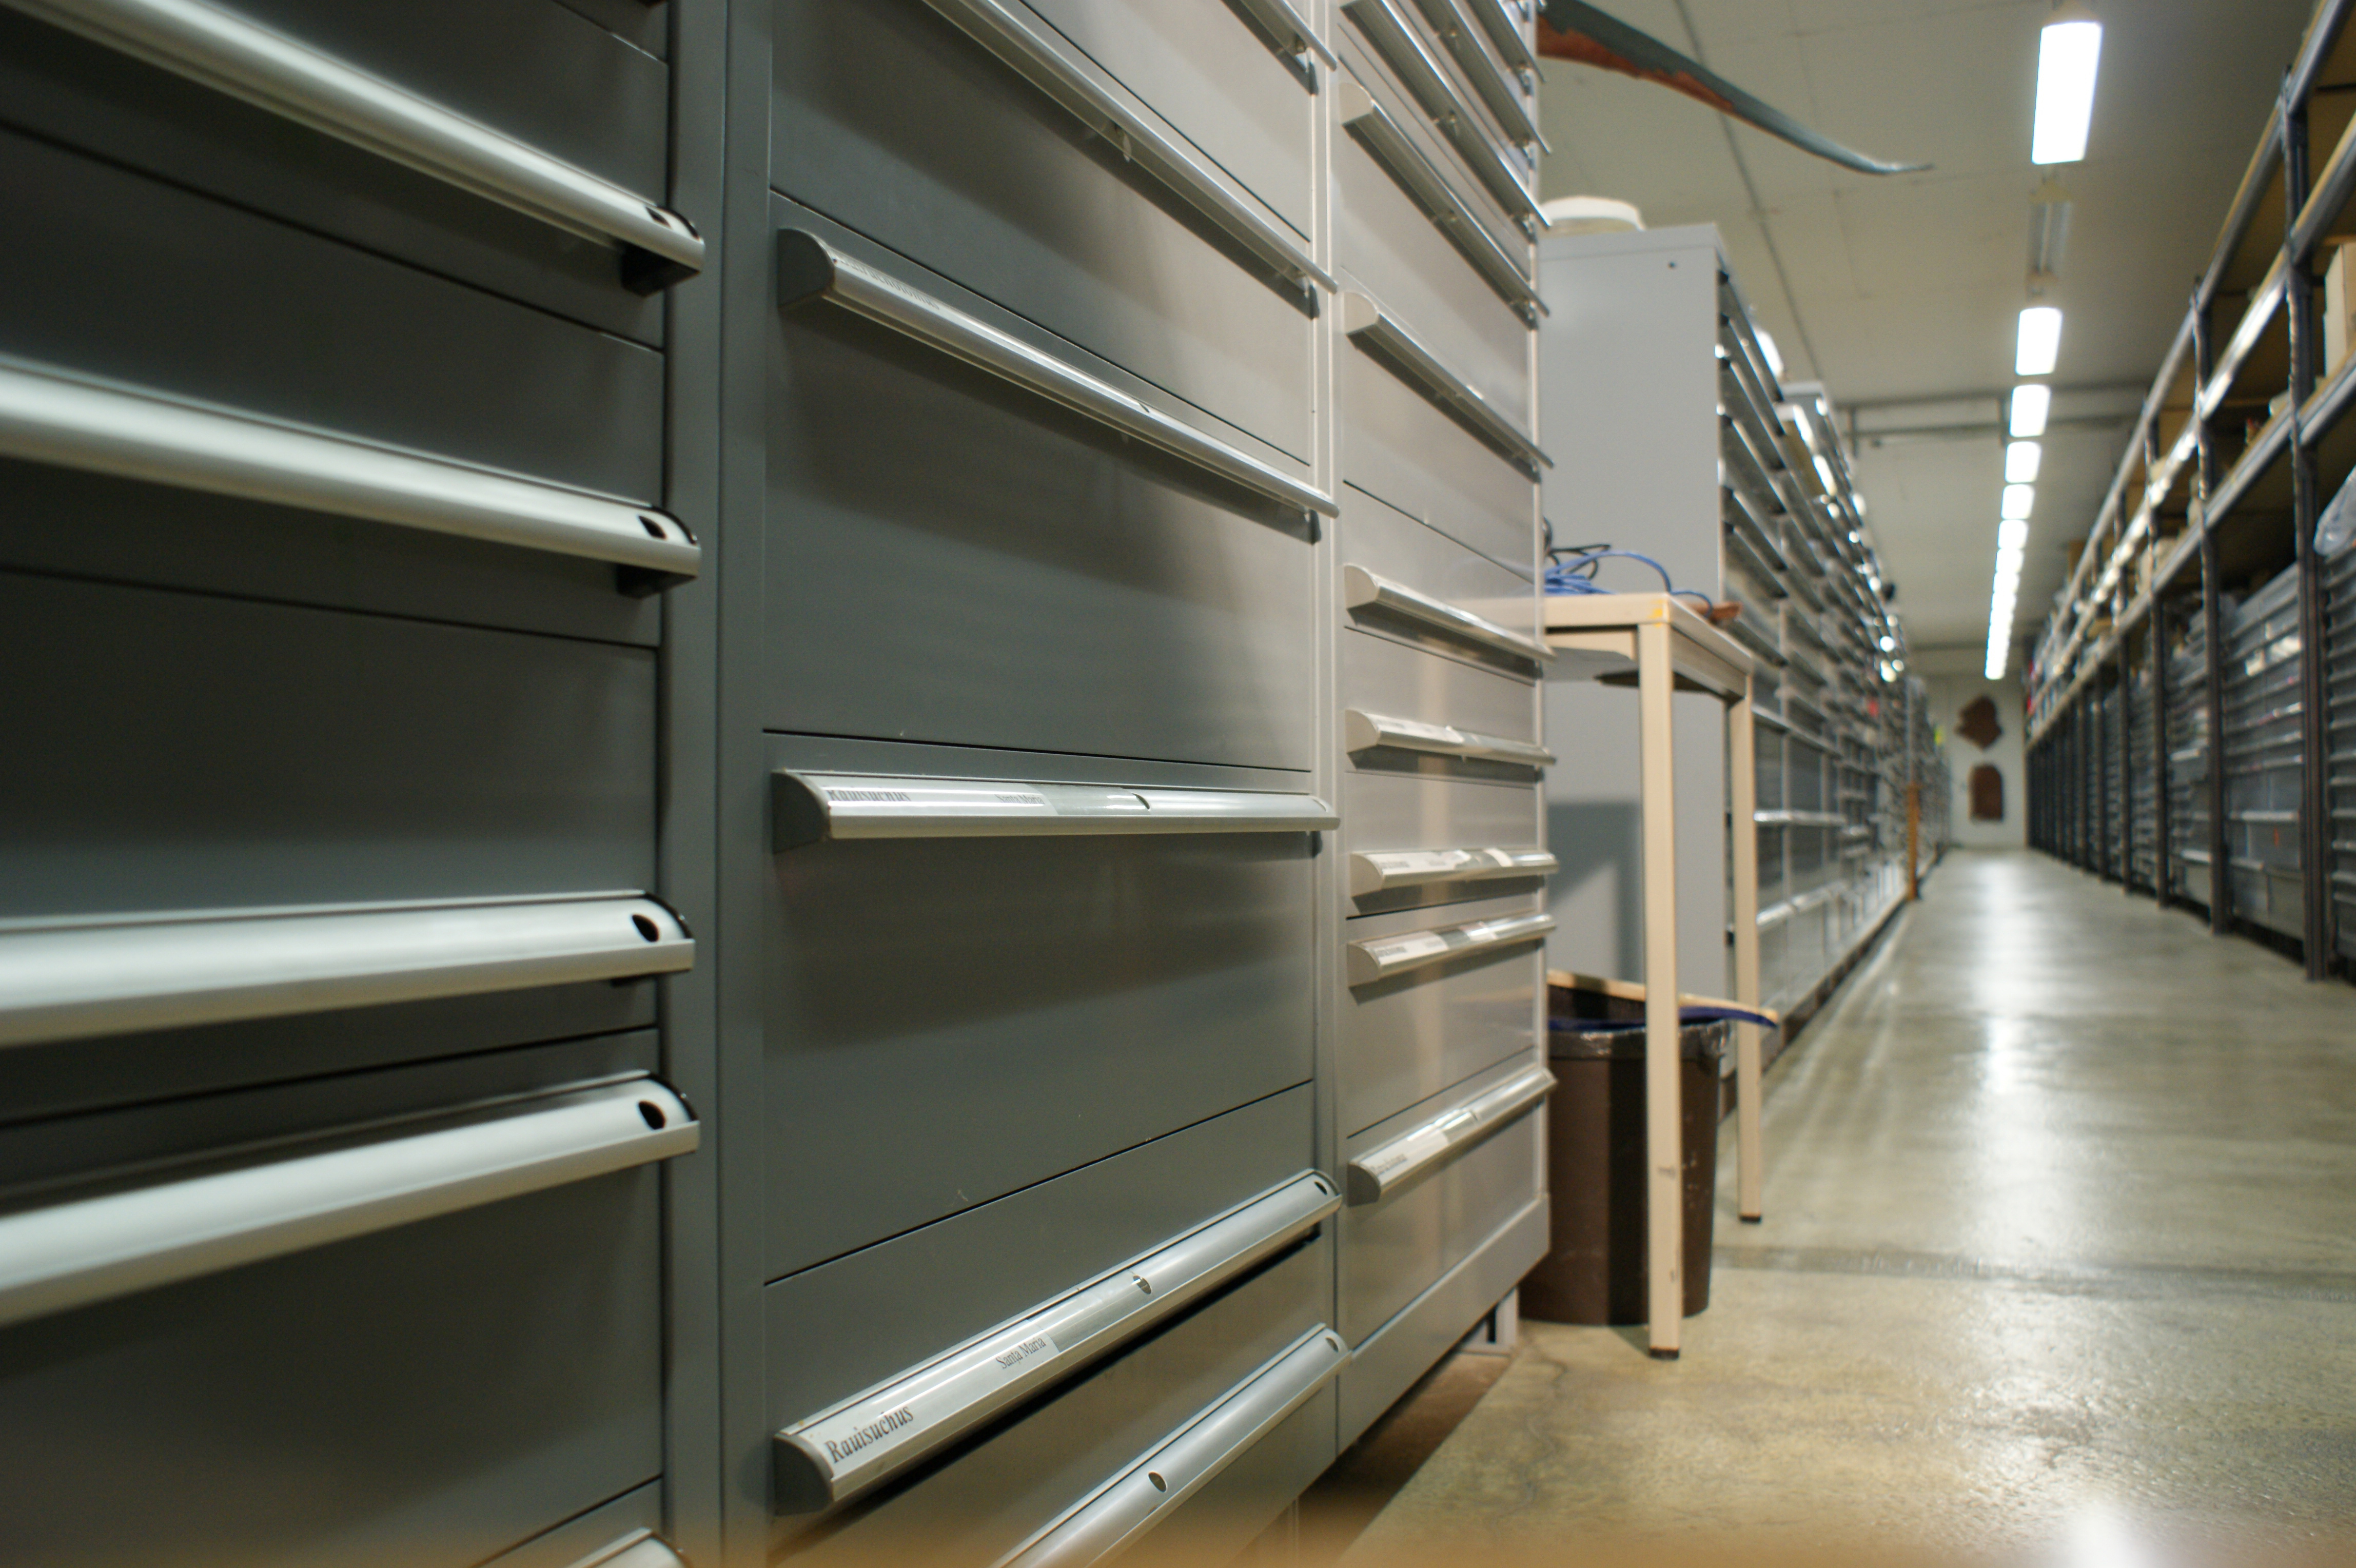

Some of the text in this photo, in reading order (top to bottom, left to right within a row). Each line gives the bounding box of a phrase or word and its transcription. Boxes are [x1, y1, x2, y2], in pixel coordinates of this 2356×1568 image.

[994, 794, 1022, 803] Santa
[1017, 794, 1046, 805] Maria
[824, 1337, 1046, 1463] Rauisuchus Santa Maria
